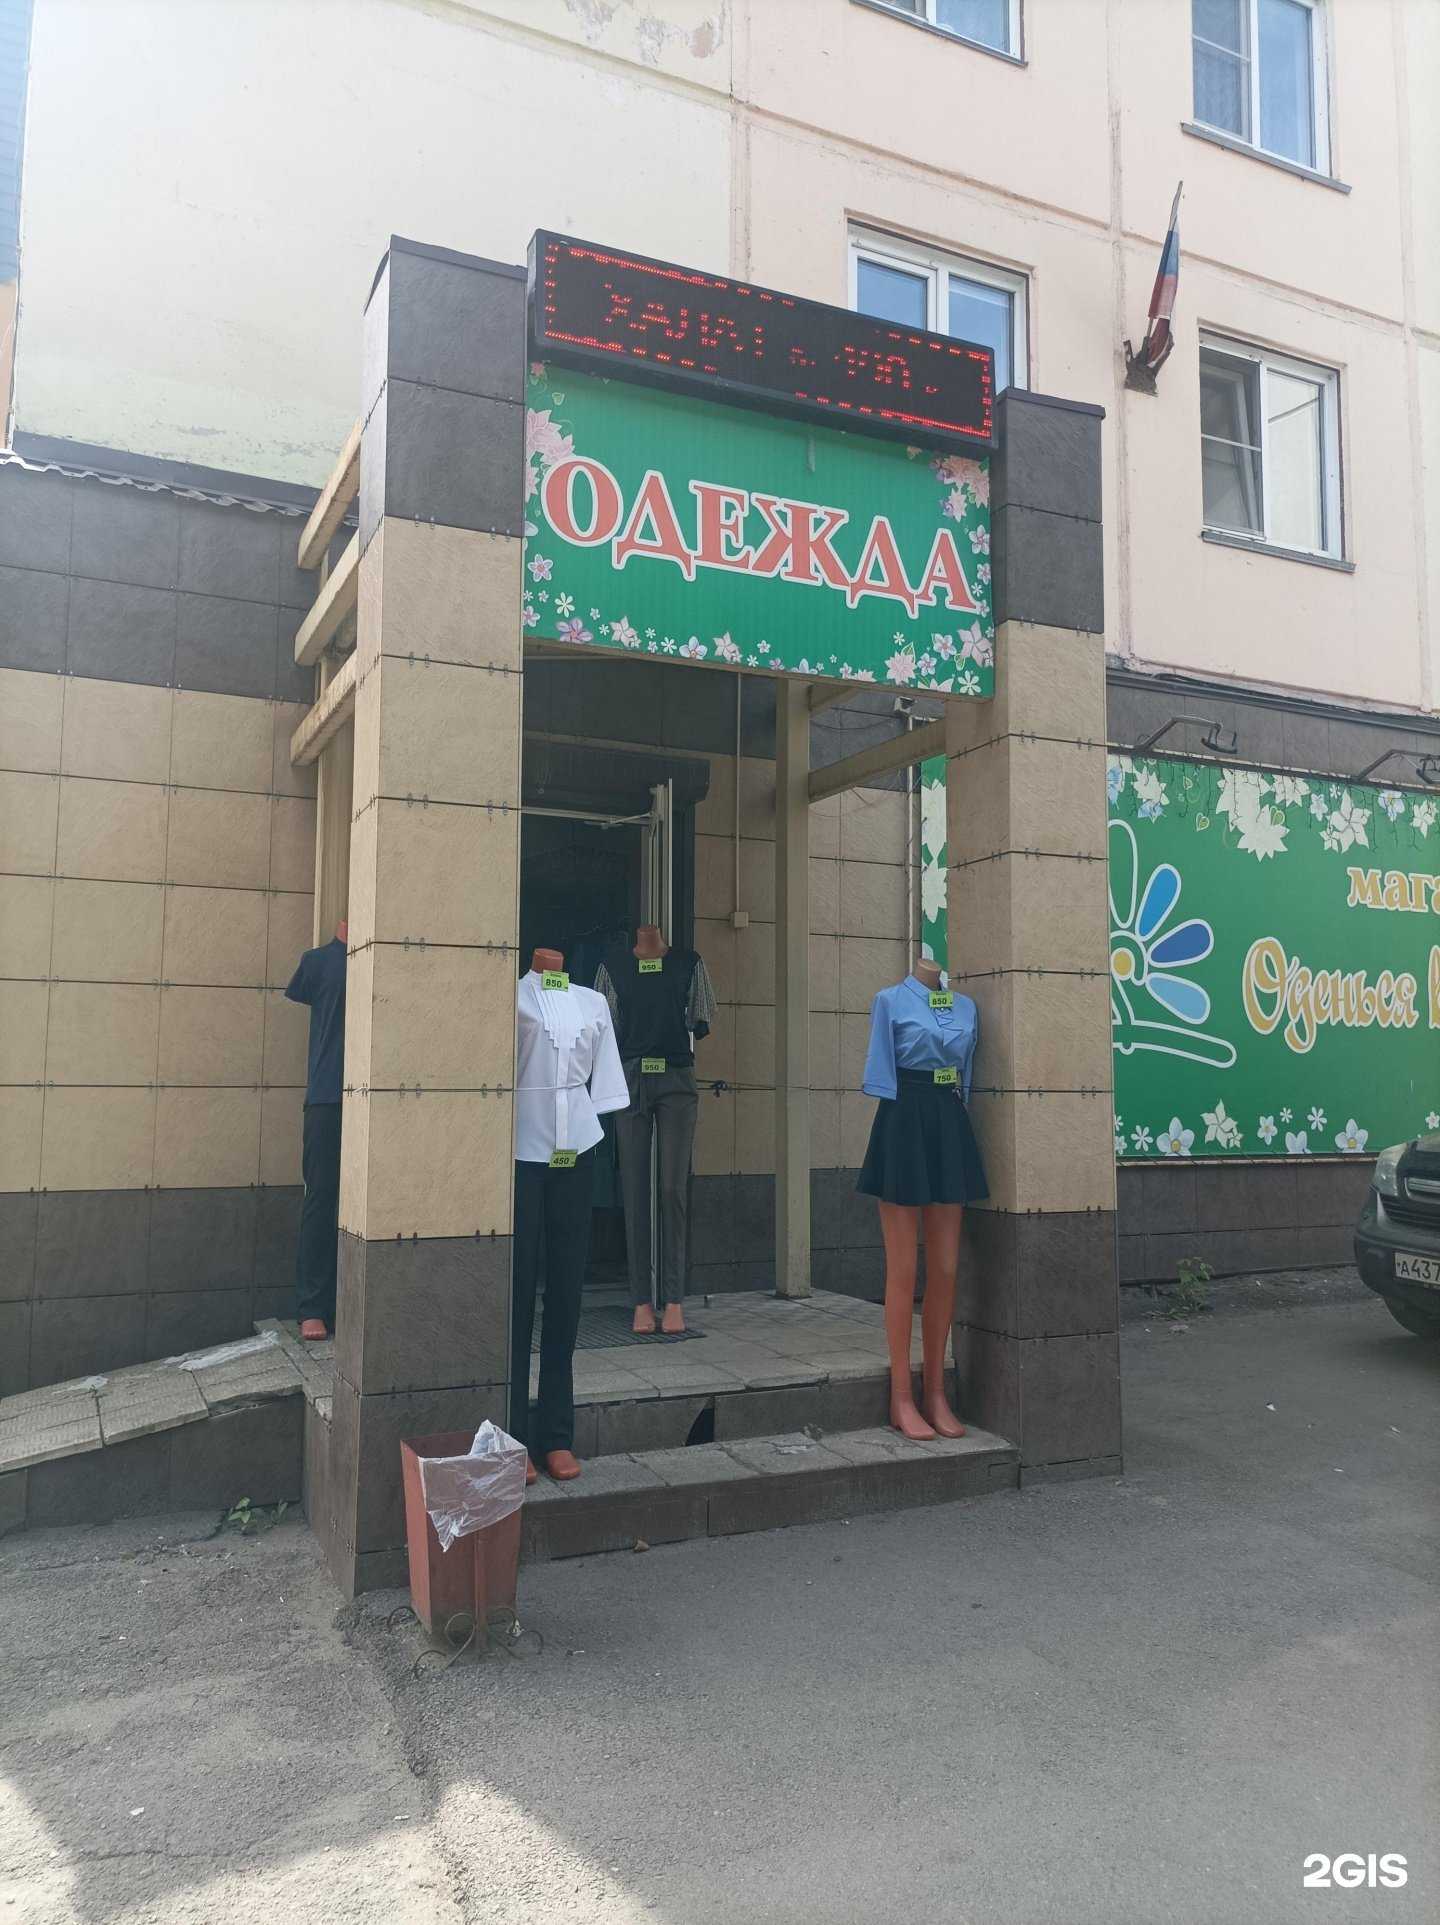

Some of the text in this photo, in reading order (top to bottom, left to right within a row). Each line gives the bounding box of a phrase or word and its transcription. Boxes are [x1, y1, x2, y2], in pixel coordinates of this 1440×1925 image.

[542, 457, 981, 618] ОДЕЖДА
[545, 978, 562, 988] 850
[1243, 936, 1419, 1053] Оденься
[936, 1074, 952, 1082] 750
[553, 1157, 570, 1165] 450
